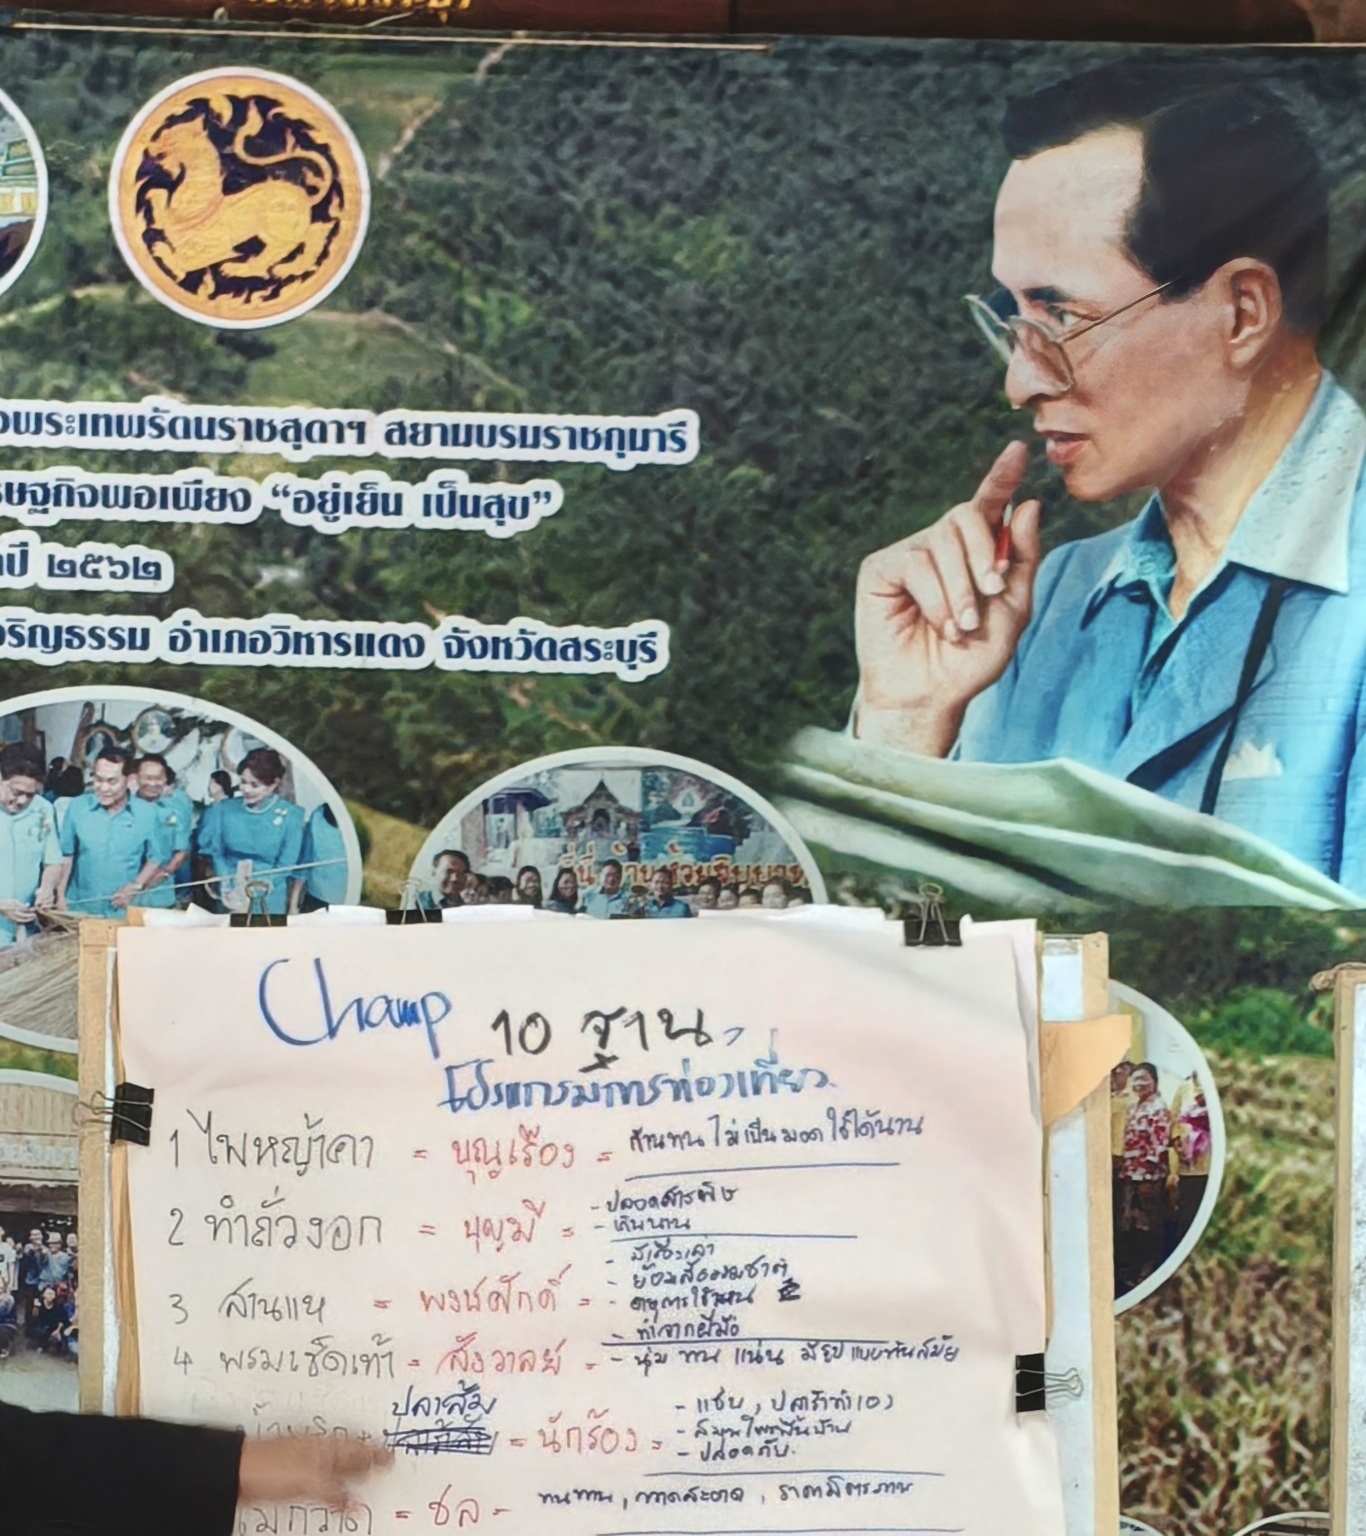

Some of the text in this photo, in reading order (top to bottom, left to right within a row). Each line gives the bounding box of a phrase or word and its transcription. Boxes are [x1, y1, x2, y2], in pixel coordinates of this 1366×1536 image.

[383, 418, 688, 458] สยามบรมราชกุมารี
[47, 553, 163, 581] ๒๕๖๒
[168, 616, 425, 659] อำเภอวิหารแดง
[443, 624, 658, 676] จังหวัดสระบุรี
[258, 957, 453, 1060] Champ
[491, 1008, 552, 1056] 10
[169, 1129, 180, 1168] 1
[169, 1208, 184, 1246] 2
[169, 1293, 188, 1324] 3
[173, 1346, 193, 1376] 4
